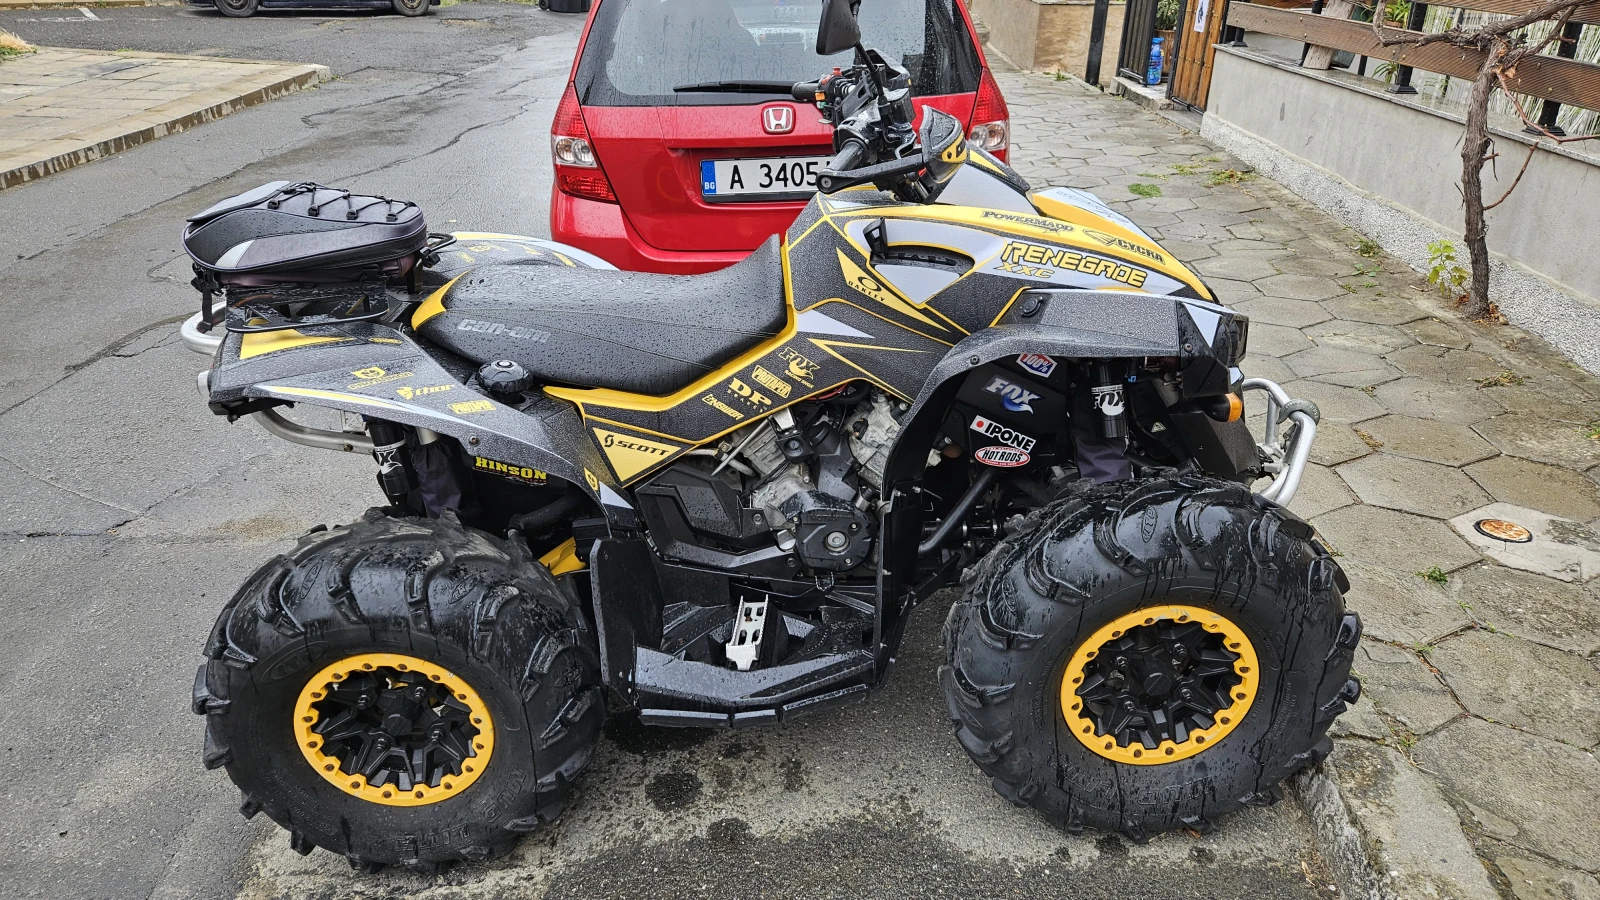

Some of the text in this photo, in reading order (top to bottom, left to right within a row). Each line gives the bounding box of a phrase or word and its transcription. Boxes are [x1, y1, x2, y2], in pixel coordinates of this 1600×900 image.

[704, 182, 715, 190] BG
[729, 161, 819, 189] A 3405
[981, 210, 1075, 233] POWERMADD
[1116, 238, 1166, 265] CYCRA
[995, 262, 1055, 279] XXC
[1000, 240, 1149, 289] RENEGADE
[848, 280, 886, 302] OAKLEY
[778, 346, 821, 371] FOX
[1021, 353, 1052, 373] 100%
[415, 383, 455, 396] thor
[728, 377, 772, 406] DP
[753, 366, 790, 398] PROTAPER
[985, 377, 1041, 404] FOX
[614, 440, 670, 456] SCOTT
[984, 421, 1034, 452] IPONE
[475, 456, 547, 480] HINSON
[982, 450, 1023, 462] HOT RODS
